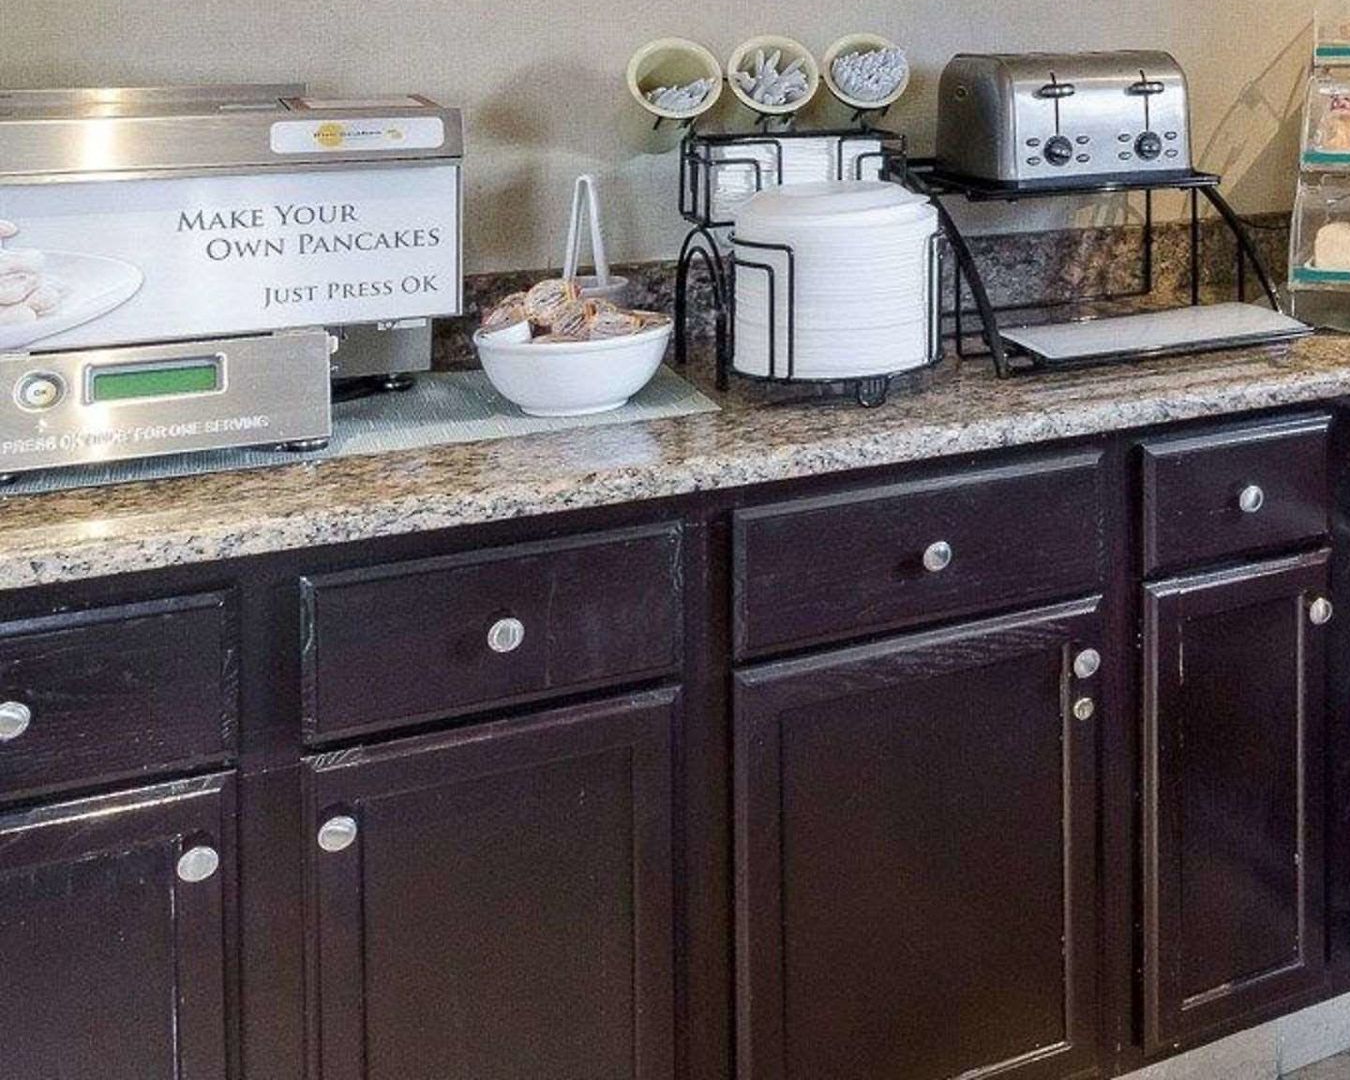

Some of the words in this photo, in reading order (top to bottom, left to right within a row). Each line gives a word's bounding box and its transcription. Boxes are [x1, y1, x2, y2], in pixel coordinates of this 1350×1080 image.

[177, 209, 264, 233] MAKE
[274, 204, 360, 226] YOUR
[206, 237, 285, 261] OWN
[299, 227, 441, 255] PANCAKES
[263, 284, 318, 309] JUST
[327, 279, 394, 301] PRESS
[401, 274, 440, 295] OK
